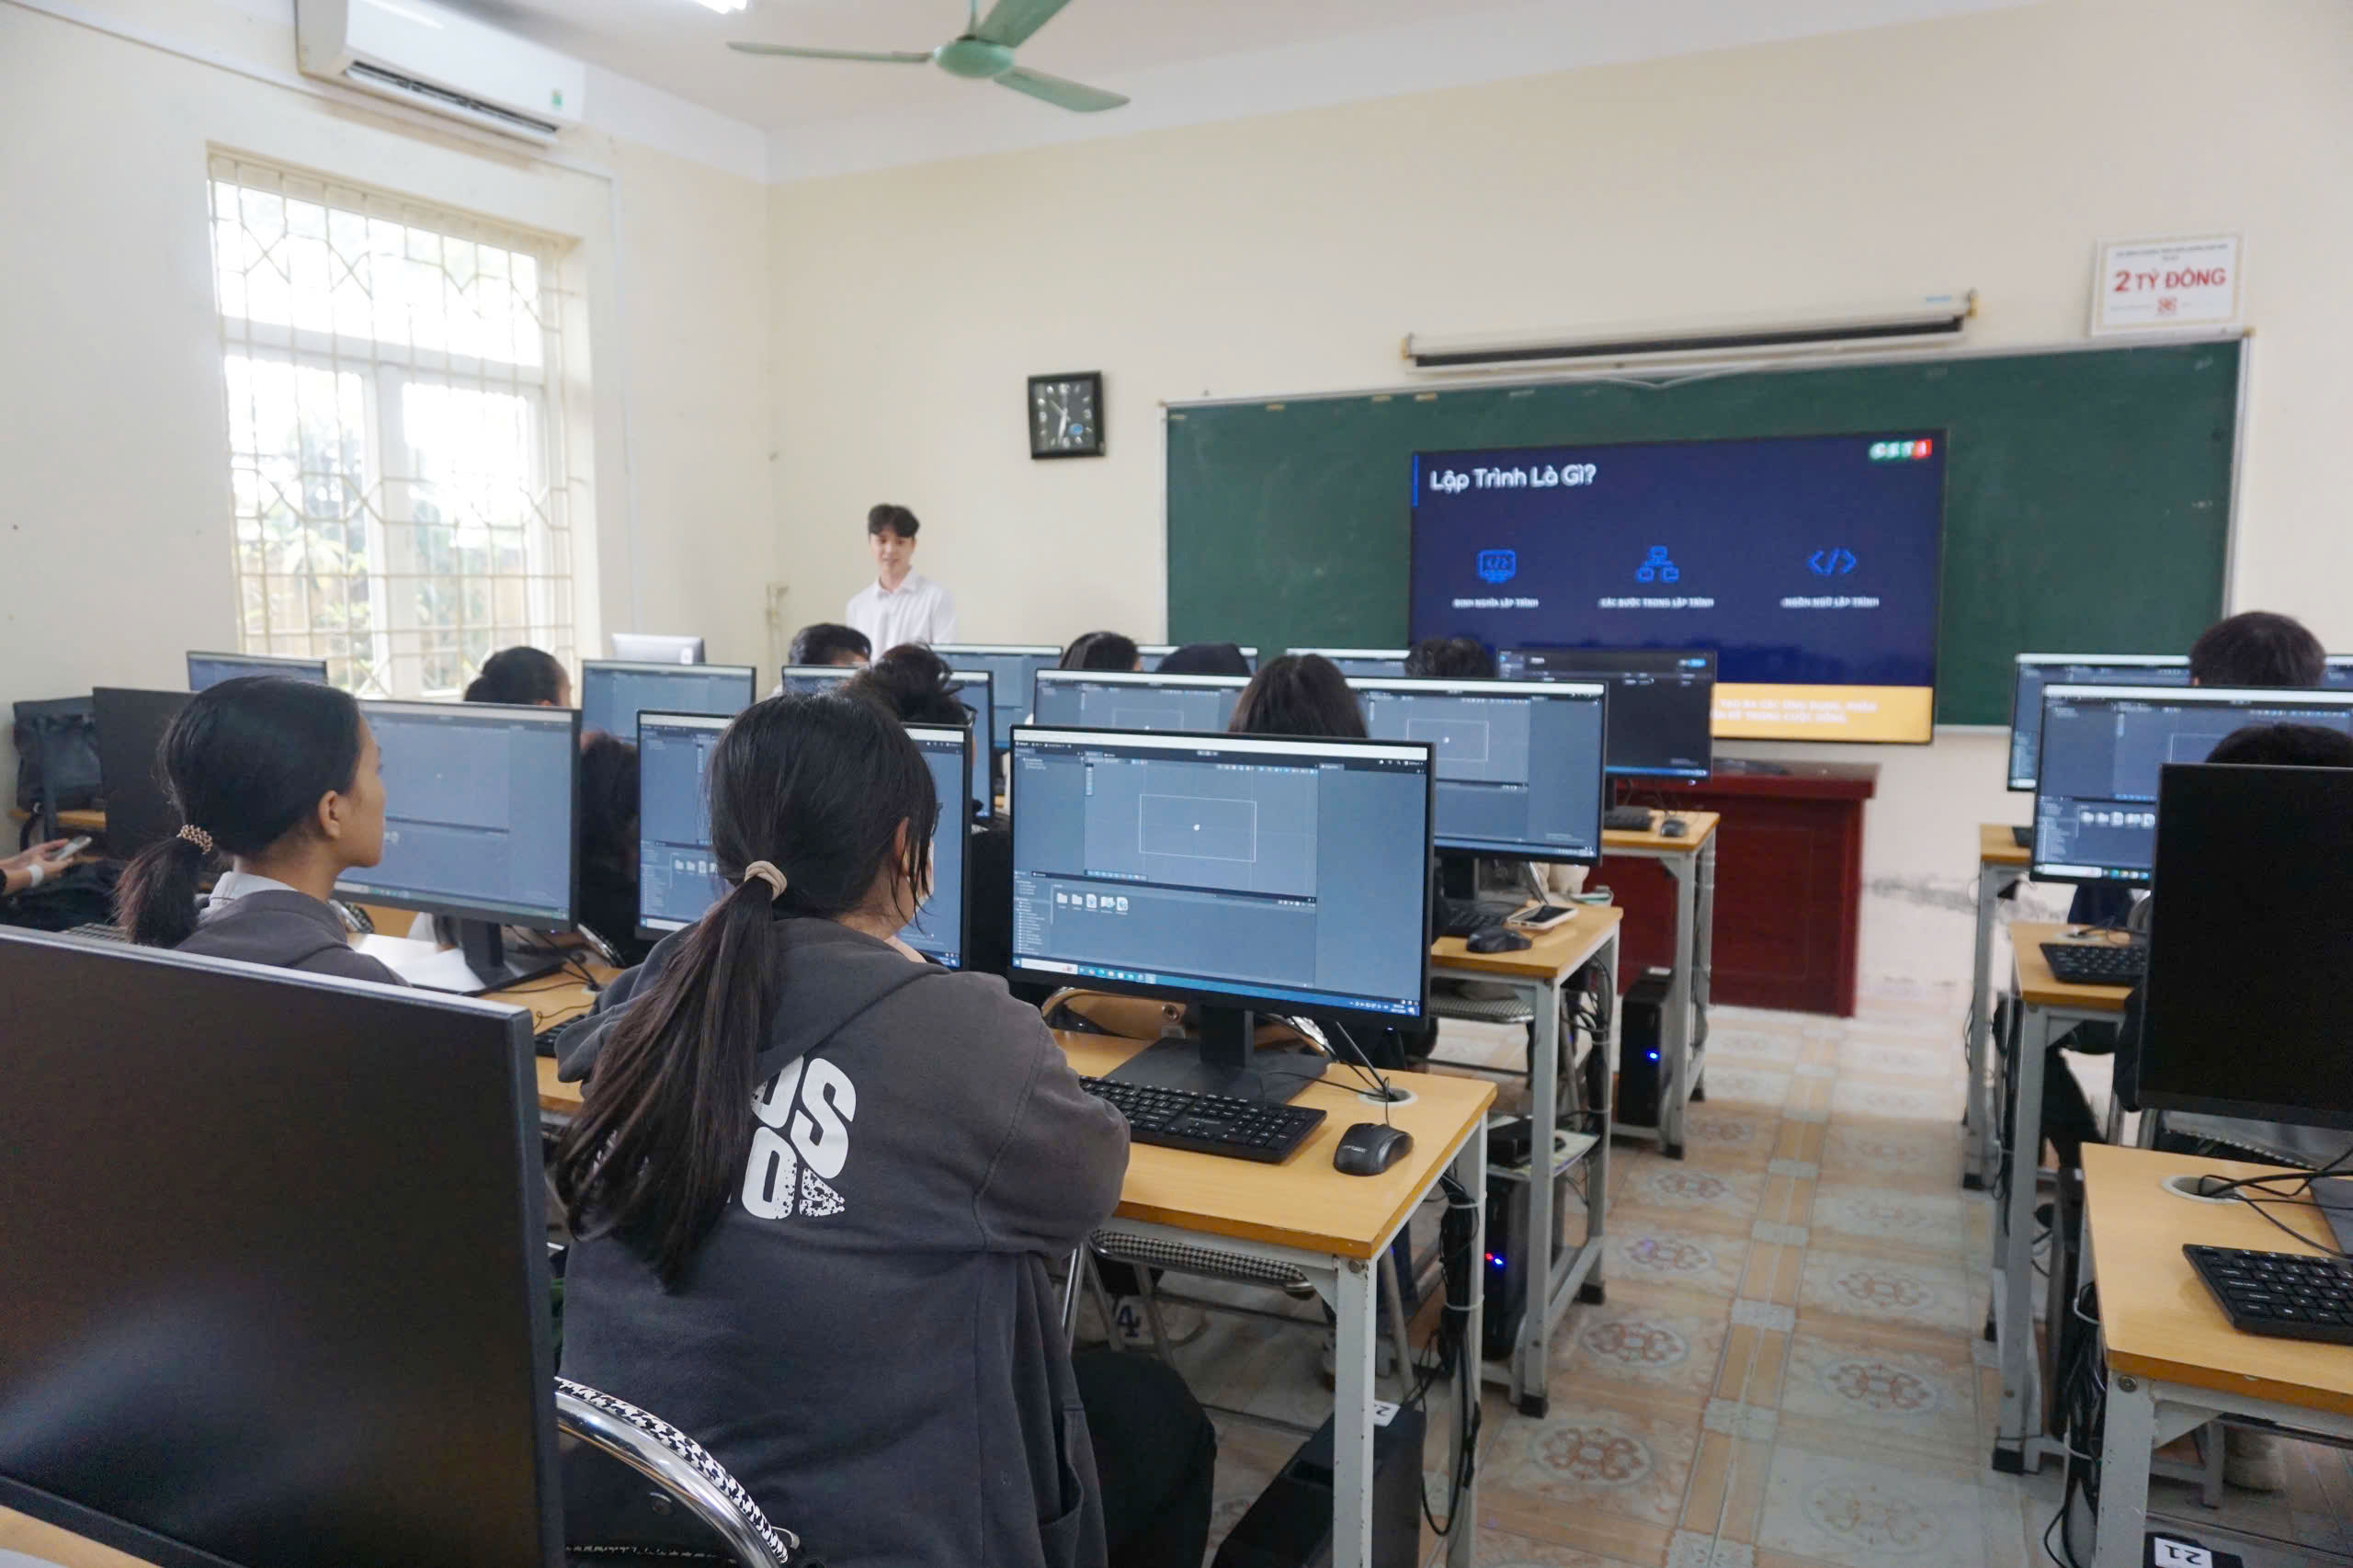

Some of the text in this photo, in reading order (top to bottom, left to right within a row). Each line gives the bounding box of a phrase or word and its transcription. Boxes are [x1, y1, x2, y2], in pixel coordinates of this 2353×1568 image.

[2114, 270, 2131, 292] 2
[1430, 462, 1597, 494] Lập Trình Là Gì?
[2165, 1543, 2202, 1565] 21
